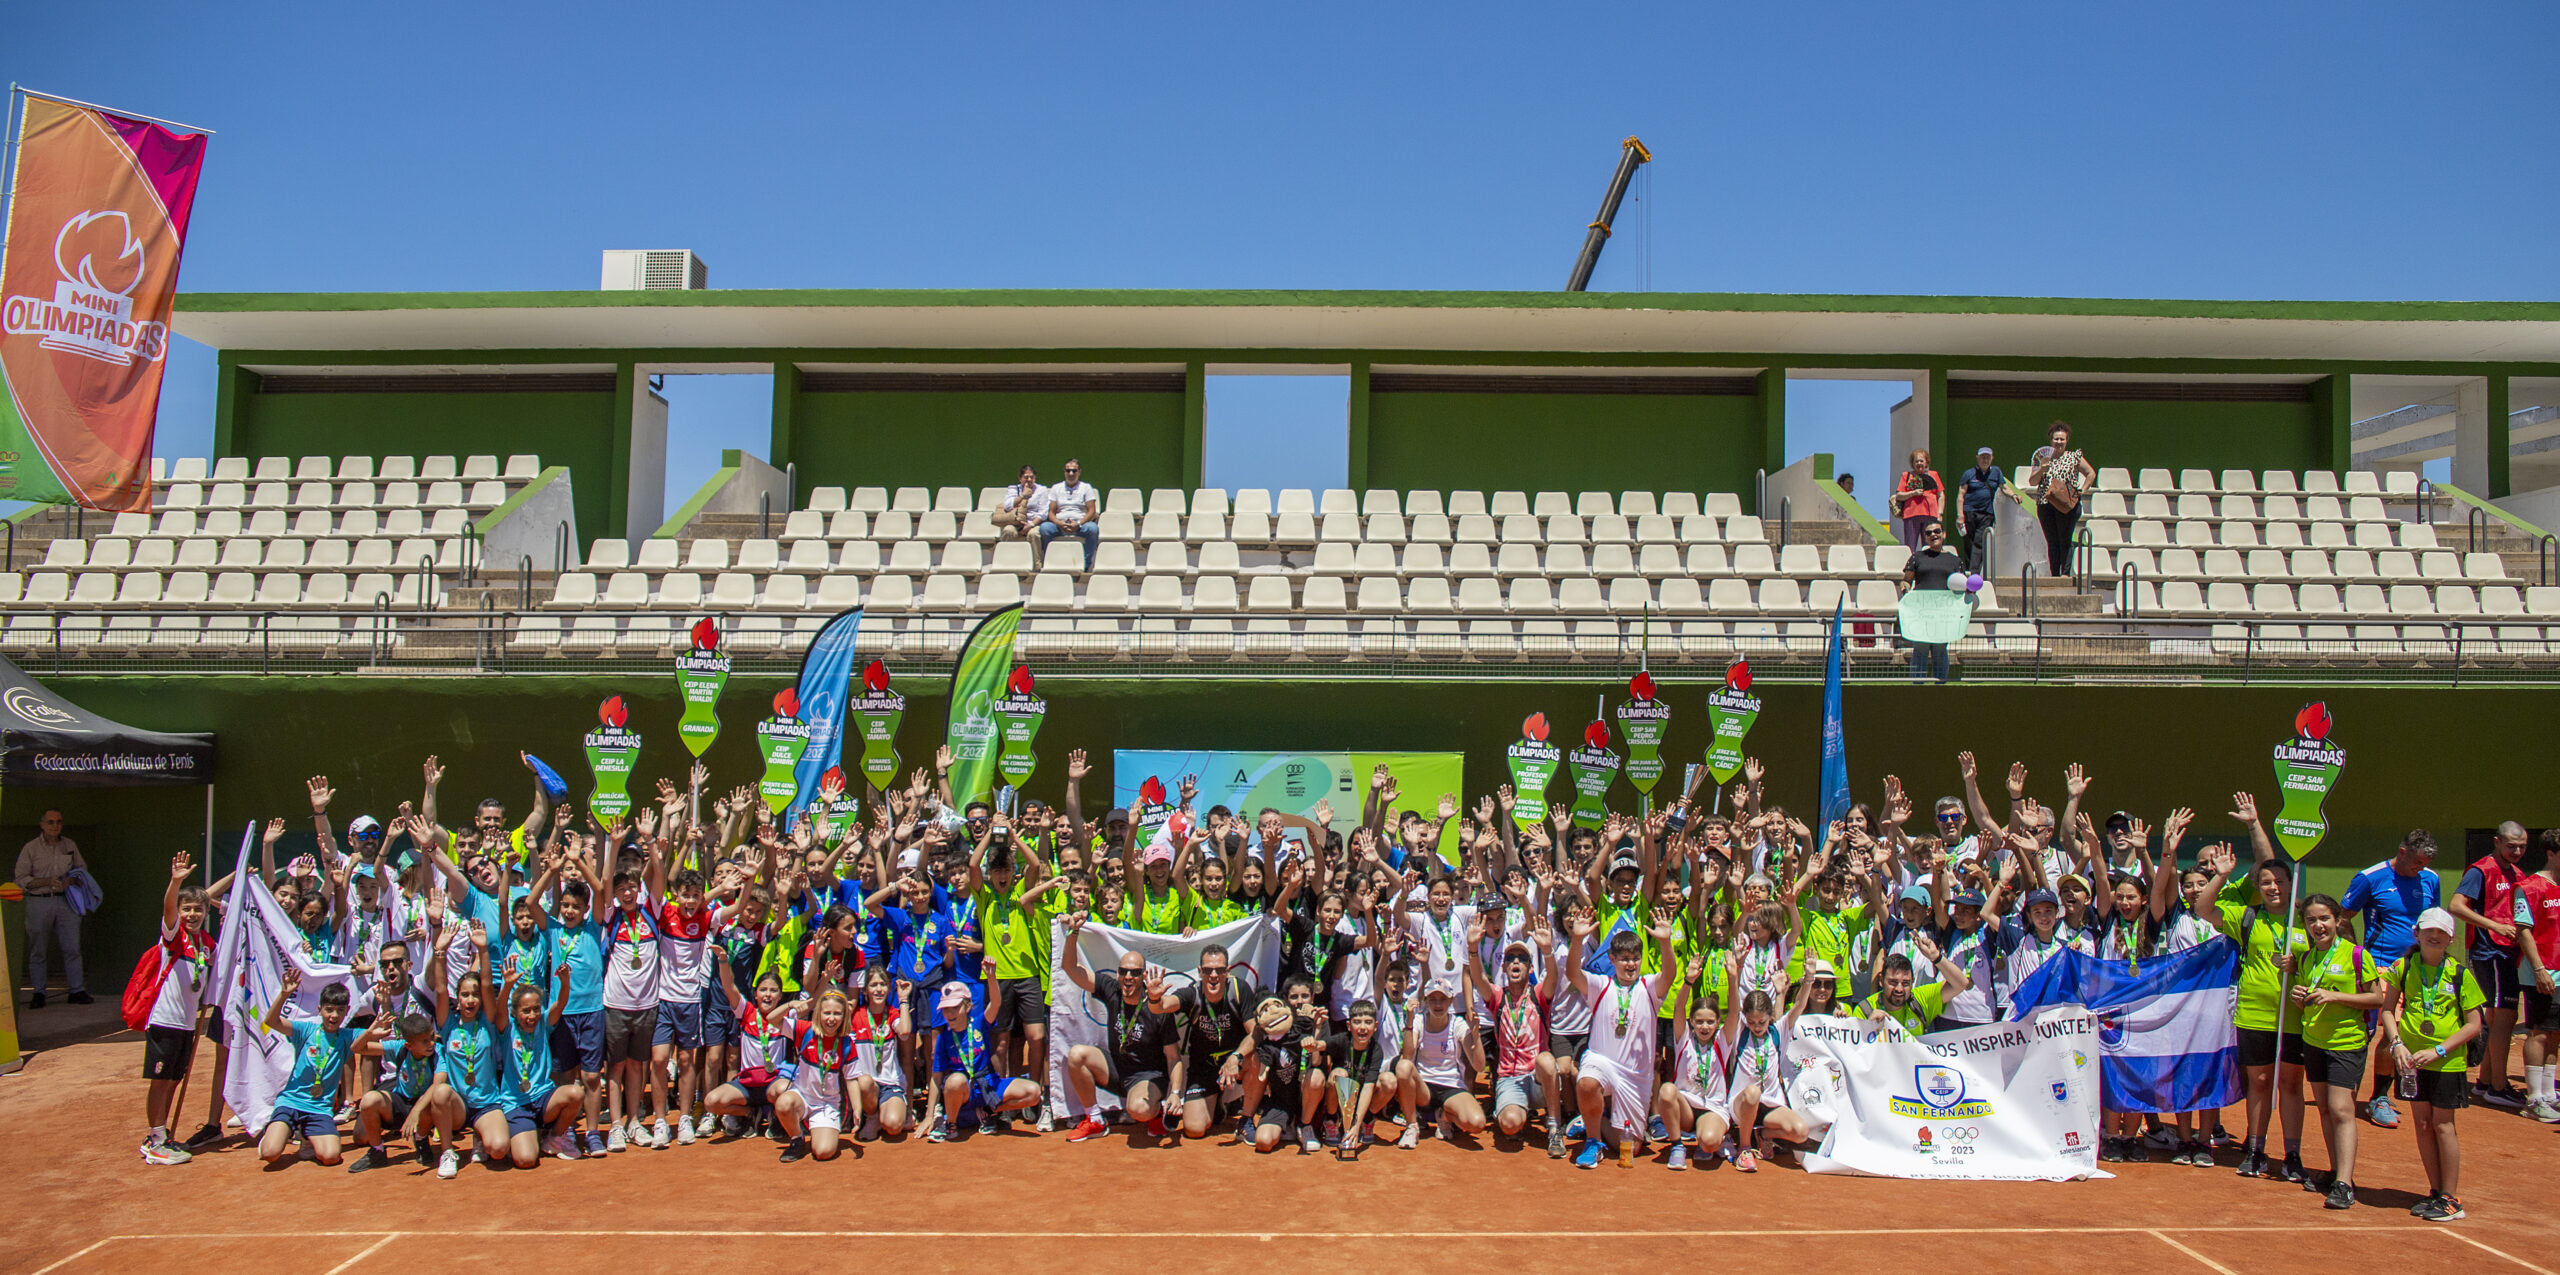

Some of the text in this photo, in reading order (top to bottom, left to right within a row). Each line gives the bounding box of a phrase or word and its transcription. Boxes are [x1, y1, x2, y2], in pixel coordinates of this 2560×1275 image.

[70, 290, 118, 315] MINI
[7, 299, 163, 358] OLIMPIADAS
[676, 656, 730, 672] OLIMPIADAS
[851, 698, 903, 710] OLIMPIADAS
[994, 700, 1045, 714] OLIMPIADAS
[1709, 694, 1761, 712] OLIMPIADAS
[1617, 707, 1669, 719] OLIMPIADAS
[758, 722, 810, 738] OLIMPIADAS
[953, 724, 996, 736] OLIMPIADS
[1720, 723, 1742, 731] CIUDAD
[1725, 730, 1743, 738] JEREZ
[585, 734, 641, 748] OLIMPIADAS
[2299, 739, 2320, 749] MINI
[1508, 745, 1560, 761] OLIMPIADAS
[2274, 745, 2344, 766] OLIMPIADAS
[34, 752, 194, 771] Federación Andaluza de Tenis
[1570, 752, 1619, 769] OLIMPIADAS
[1715, 760, 1734, 769] CÁDIZ
[2288, 774, 2324, 785] CEIP SAN
[763, 787, 793, 795] CÓRDOBA
[2283, 781, 2326, 793] FERNANDO
[601, 806, 621, 814] CÁDIZ
[1515, 811, 1541, 819] MÁLAGA
[1577, 810, 1601, 819] MÁLAGA
[2275, 817, 2325, 830] DOS HERMANAS
[2283, 827, 2316, 837] SEVILLA
[1927, 1043, 1958, 1057] NOS
[1963, 1030, 2031, 1055] INSPIRA.
[1893, 1101, 1991, 1117] SAN FERNANDO
[2059, 1145, 2091, 1155] salesianos
[1932, 1156, 1964, 1165] Sevilla
